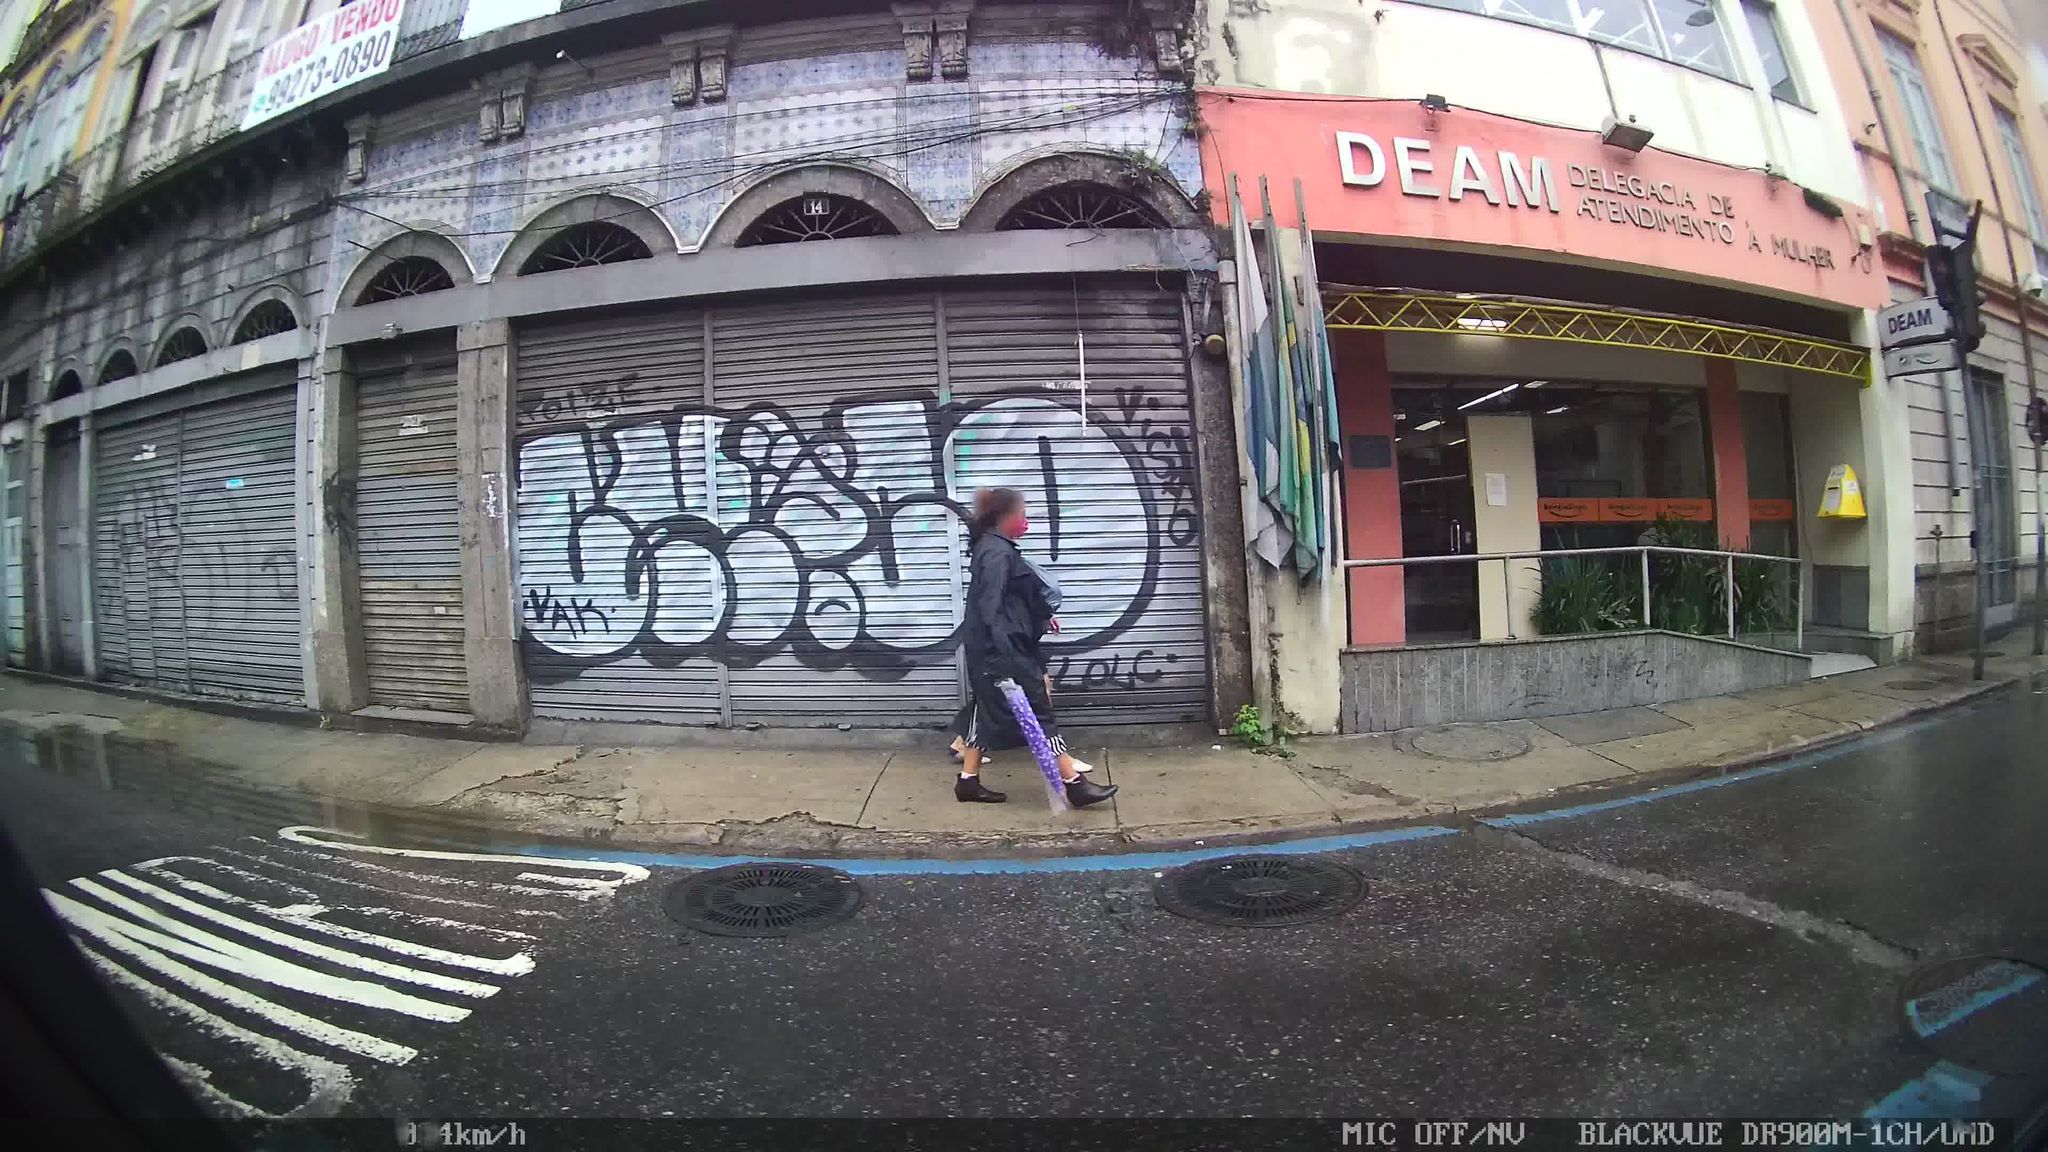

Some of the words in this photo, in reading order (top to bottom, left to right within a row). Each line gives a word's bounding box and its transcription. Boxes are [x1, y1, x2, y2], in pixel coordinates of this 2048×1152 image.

[331, 0, 399, 44] VENDO
[1336, 130, 1560, 213] DEAM
[1567, 163, 1697, 211] DELEGACIA
[1707, 191, 1736, 219] DE
[1577, 196, 1735, 245] ATENDIMENTO
[1771, 233, 1836, 271] MULHER
[1887, 308, 1933, 335] DEAM
